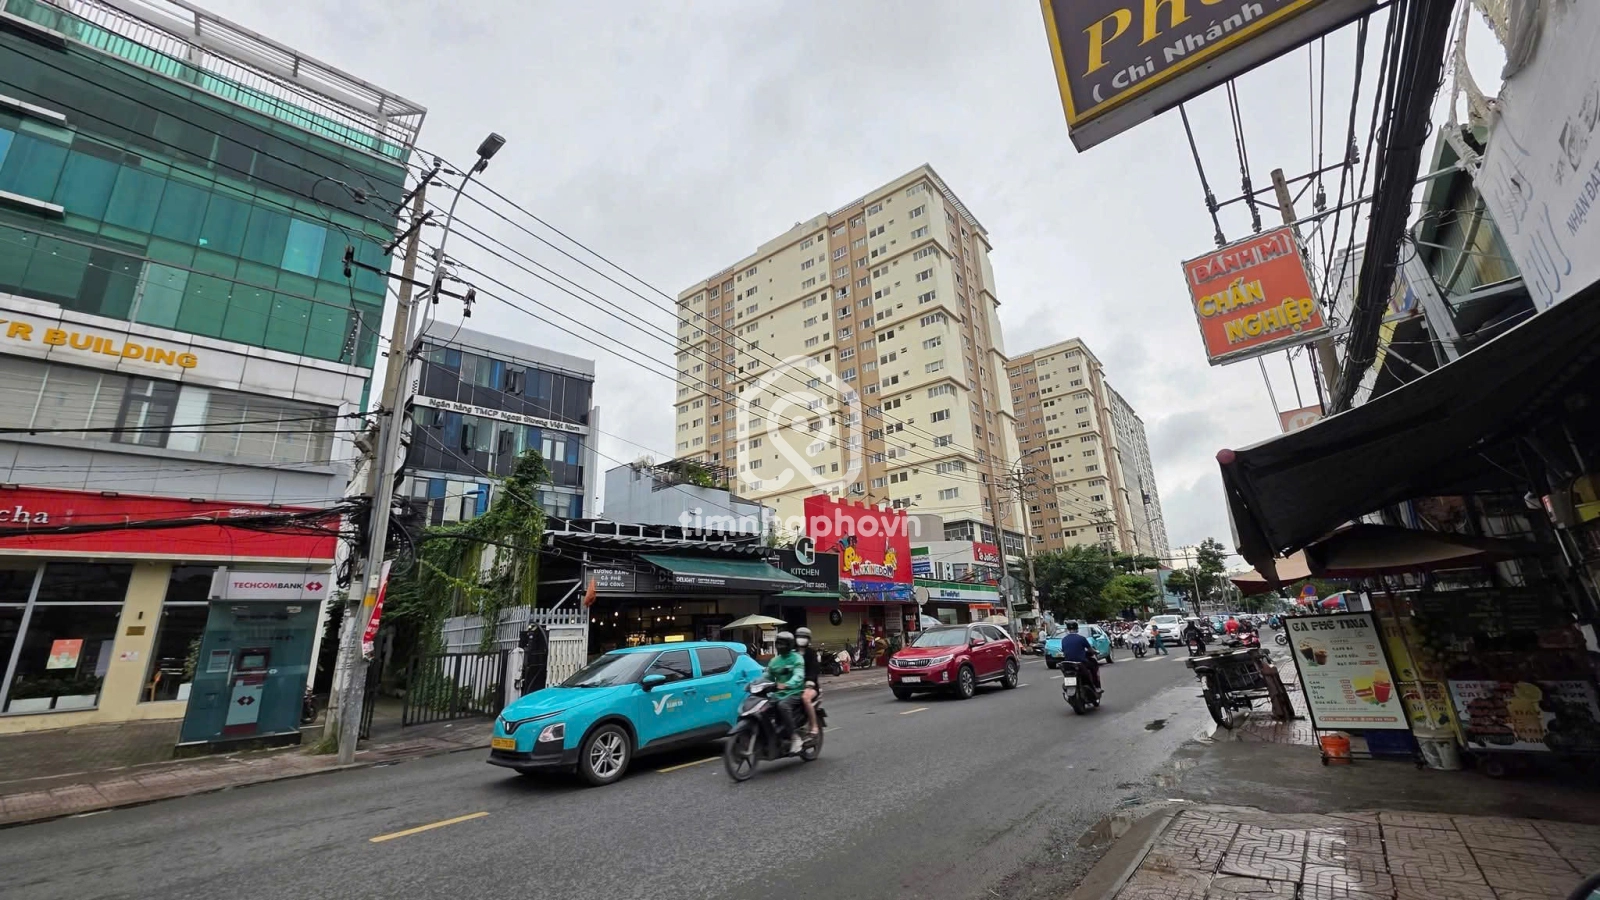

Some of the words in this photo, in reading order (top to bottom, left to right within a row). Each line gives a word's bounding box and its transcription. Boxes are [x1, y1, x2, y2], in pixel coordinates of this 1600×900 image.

[1082, 0, 1218, 77] Ph
[1112, 56, 1155, 89] Chi
[1163, 2, 1263, 64] Nhánh
[1192, 246, 1260, 284] BÁNH
[1259, 233, 1292, 262] MÌ
[1198, 277, 1265, 317] CHẤN
[1223, 297, 1314, 344] NGHIỆP
[43, 328, 198, 368] BUILDING
[474, 407, 499, 416] TMCP
[790, 568, 820, 576] KITCHEN
